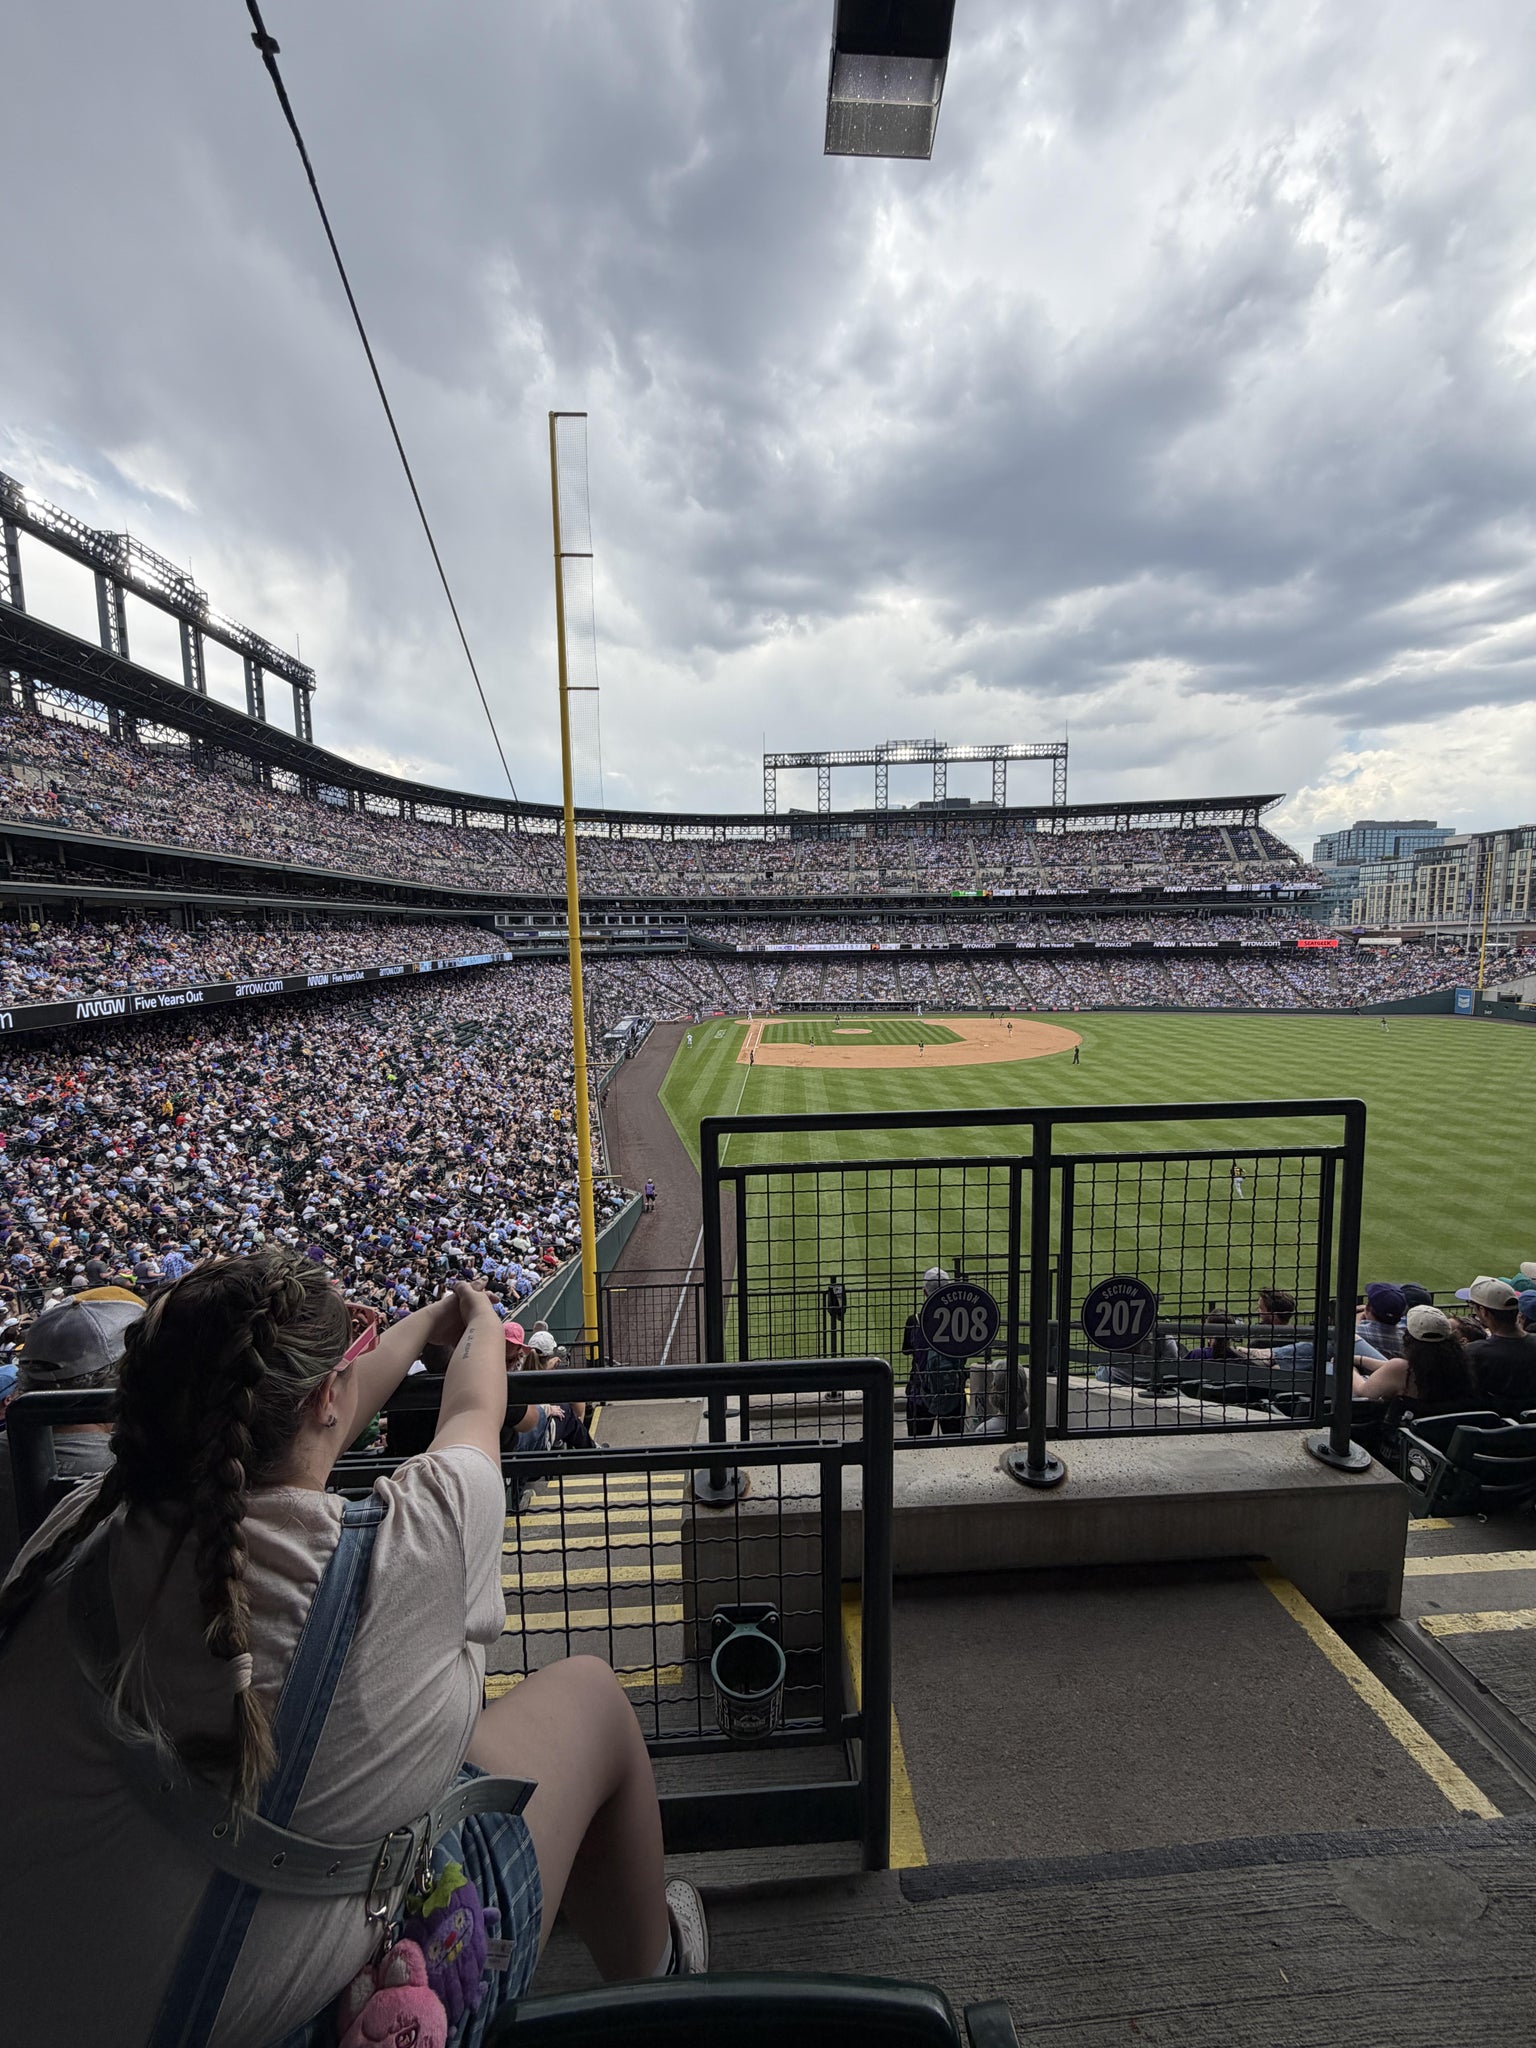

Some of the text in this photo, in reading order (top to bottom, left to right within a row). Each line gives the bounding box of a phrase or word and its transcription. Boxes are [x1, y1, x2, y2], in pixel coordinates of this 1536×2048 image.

[332, 973, 343, 983] Five
[343, 972, 356, 982] Years
[355, 971, 365, 980] Out
[235, 980, 284, 997] arrow.com
[134, 996, 157, 1010] Five
[158, 993, 185, 1007] Years
[186, 990, 204, 1003] Out
[940, 1290, 980, 1306] SECTION
[1101, 1284, 1138, 1301] SECTION
[932, 1306, 989, 1343] 208
[1094, 1299, 1146, 1337] 207
